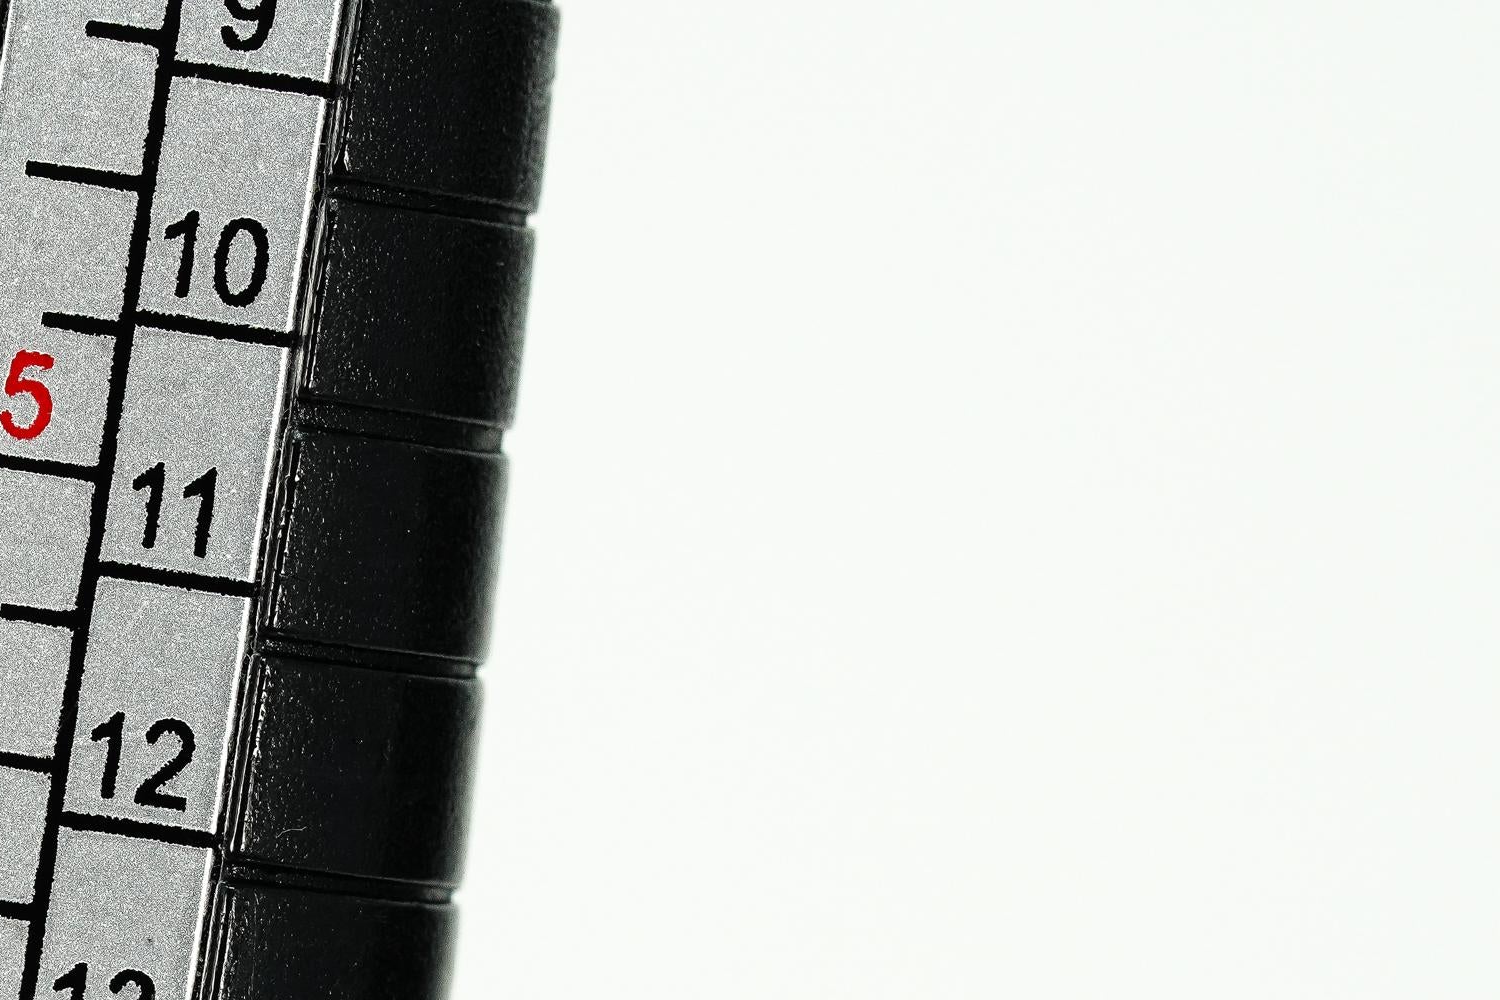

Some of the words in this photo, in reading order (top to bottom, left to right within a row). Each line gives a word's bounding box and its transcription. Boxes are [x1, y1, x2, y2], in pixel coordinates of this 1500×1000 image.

[164, 210, 270, 308] 10
[0, 350, 54, 440] 5
[133, 462, 218, 558] 11
[90, 711, 196, 813] 12
